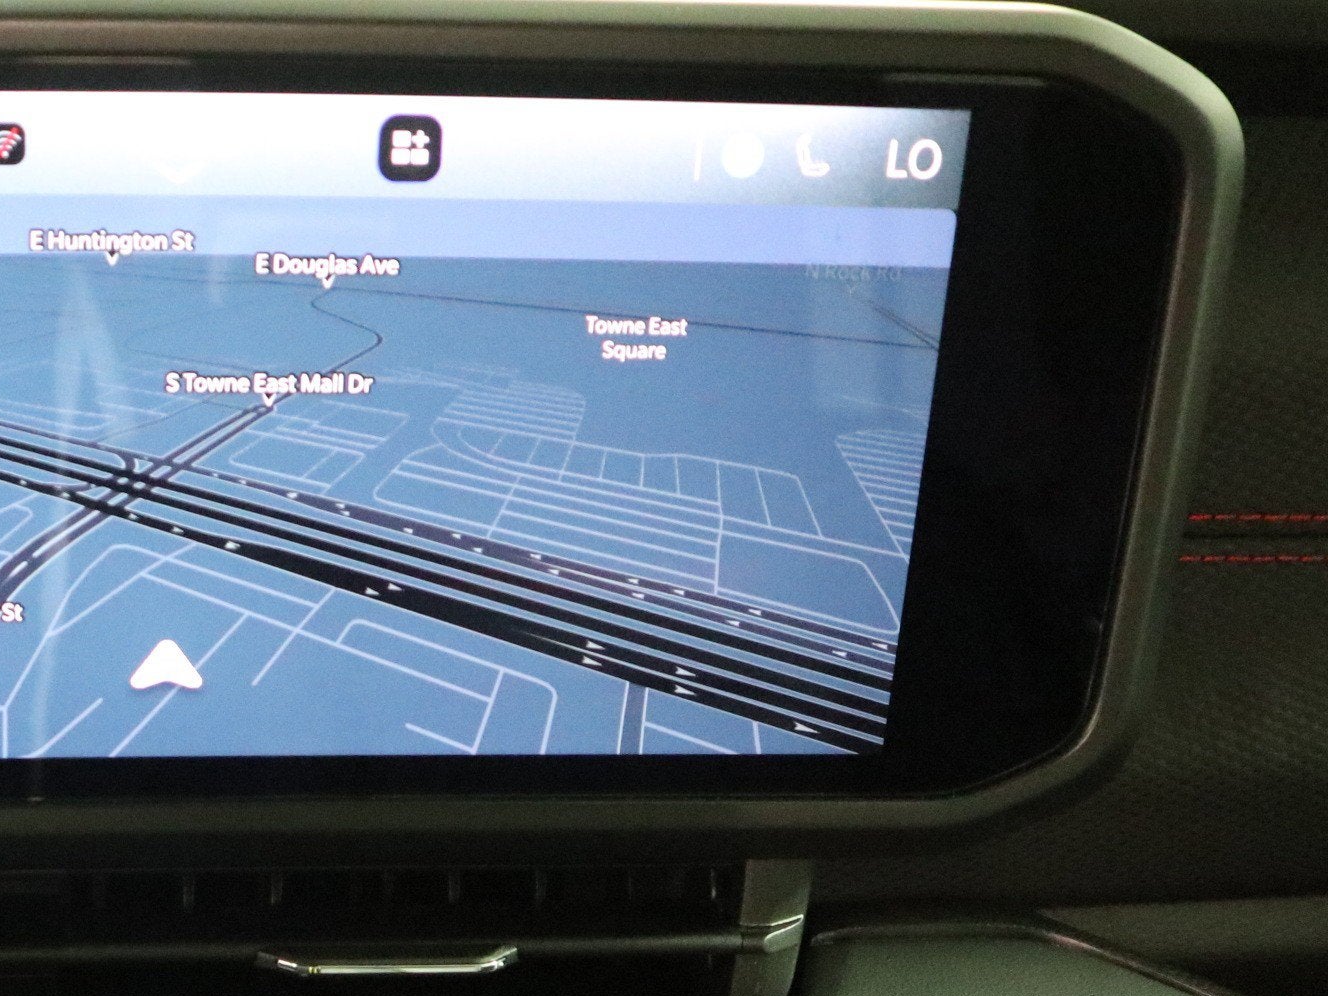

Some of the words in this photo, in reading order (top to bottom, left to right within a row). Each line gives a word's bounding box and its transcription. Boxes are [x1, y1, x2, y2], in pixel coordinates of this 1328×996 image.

[886, 138, 943, 180] LO
[29, 229, 44, 250] E
[47, 229, 168, 255] Huntington
[172, 230, 195, 251] St
[255, 253, 270, 275] E
[272, 253, 357, 280] Douglas
[360, 255, 400, 276] Ave
[585, 315, 646, 336] Towne
[649, 317, 688, 337] East
[601, 340, 667, 362] Square
[165, 372, 181, 393] S
[183, 372, 251, 394] Towne
[254, 373, 296, 395] East
[300, 373, 344, 394] Mall
[347, 373, 374, 394] Dr
[1, 603, 24, 623] St
